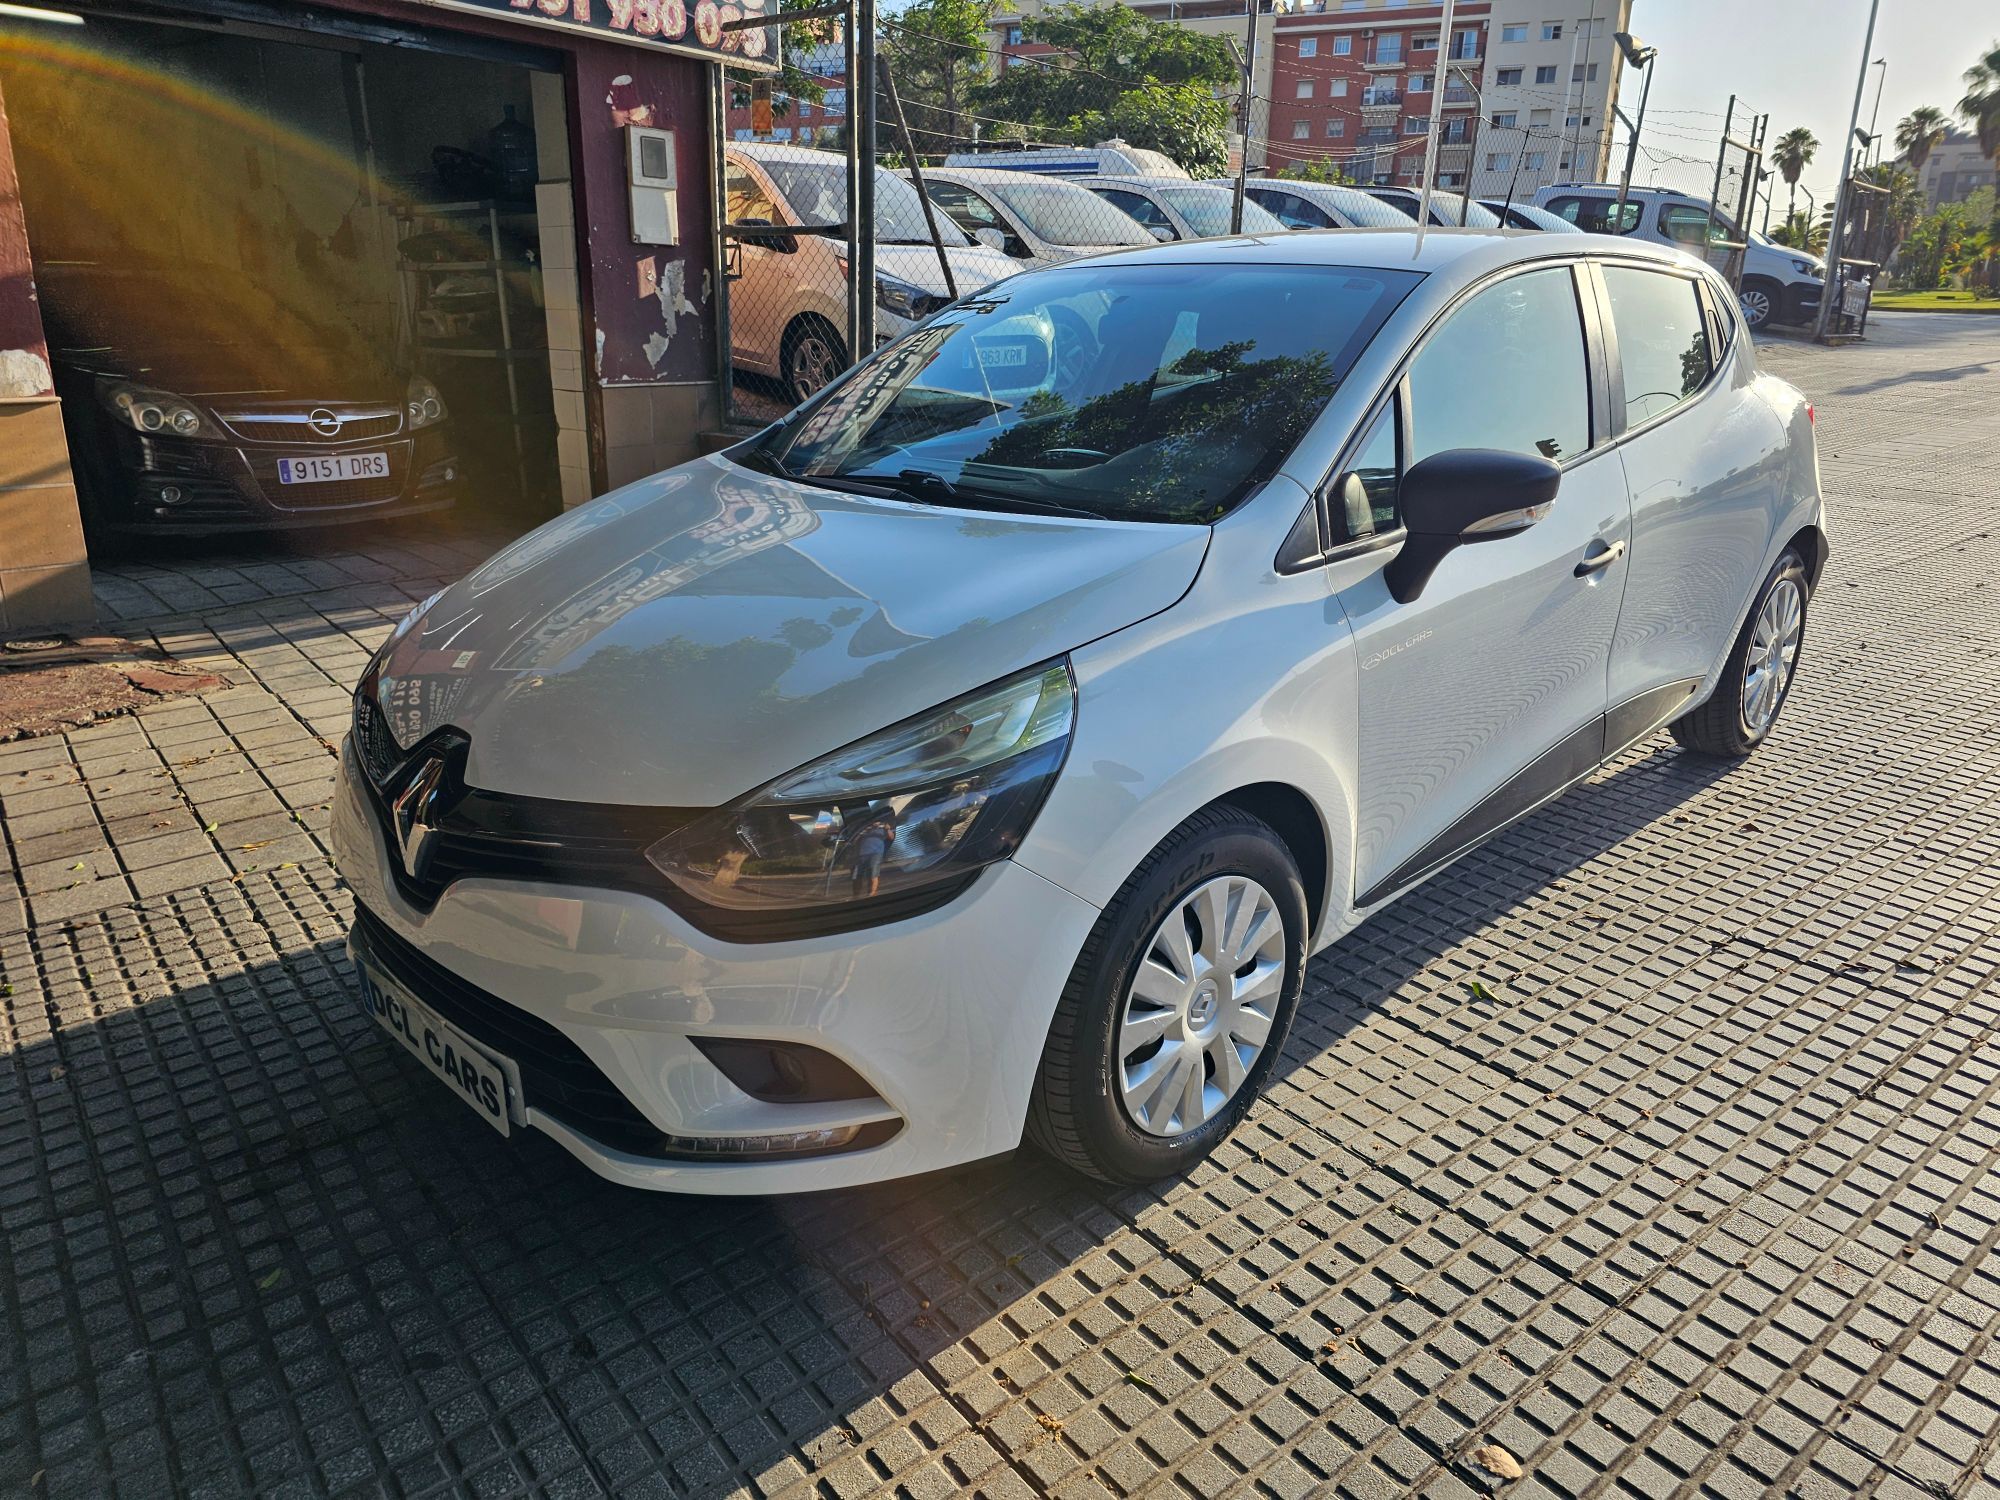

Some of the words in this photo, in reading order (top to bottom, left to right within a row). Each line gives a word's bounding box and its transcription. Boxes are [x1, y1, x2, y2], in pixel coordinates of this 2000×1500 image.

[295, 459, 343, 479] 9151
[351, 456, 383, 476] DRS
[1382, 643, 1405, 661] DCL
[1405, 629, 1433, 648] CARS
[369, 978, 420, 1049] DCL
[424, 1027, 501, 1118] CARS
